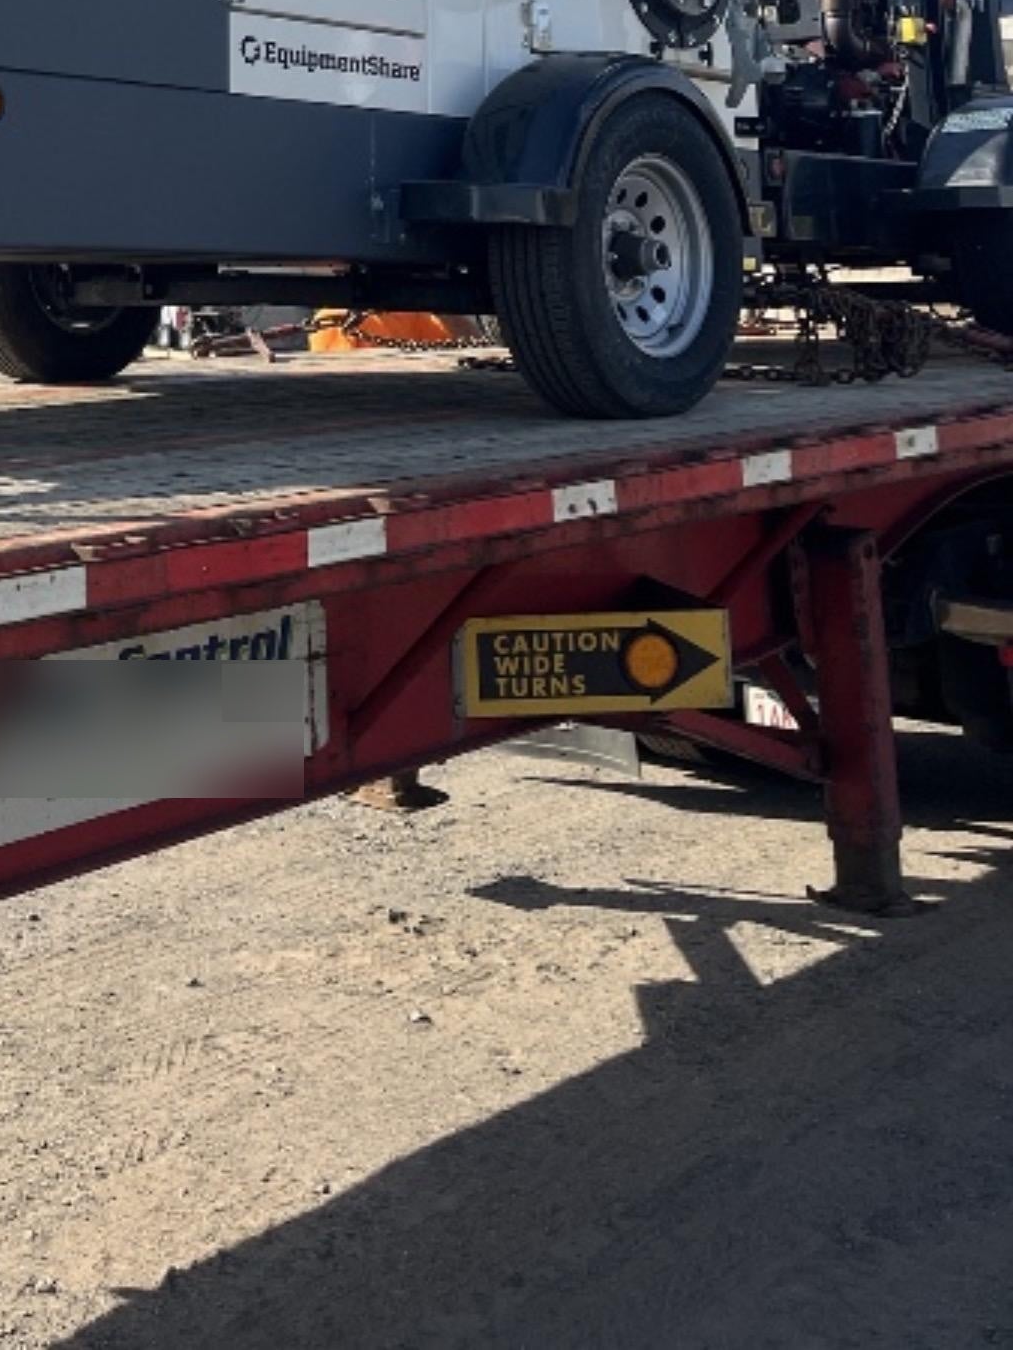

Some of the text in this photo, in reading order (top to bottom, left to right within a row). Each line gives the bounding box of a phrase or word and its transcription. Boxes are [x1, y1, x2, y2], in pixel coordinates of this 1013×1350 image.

[263, 41, 421, 82] EquipmentShare
[493, 630, 621, 654] CAUTION
[493, 653, 566, 676] WIDE
[494, 674, 587, 697] TURNS
